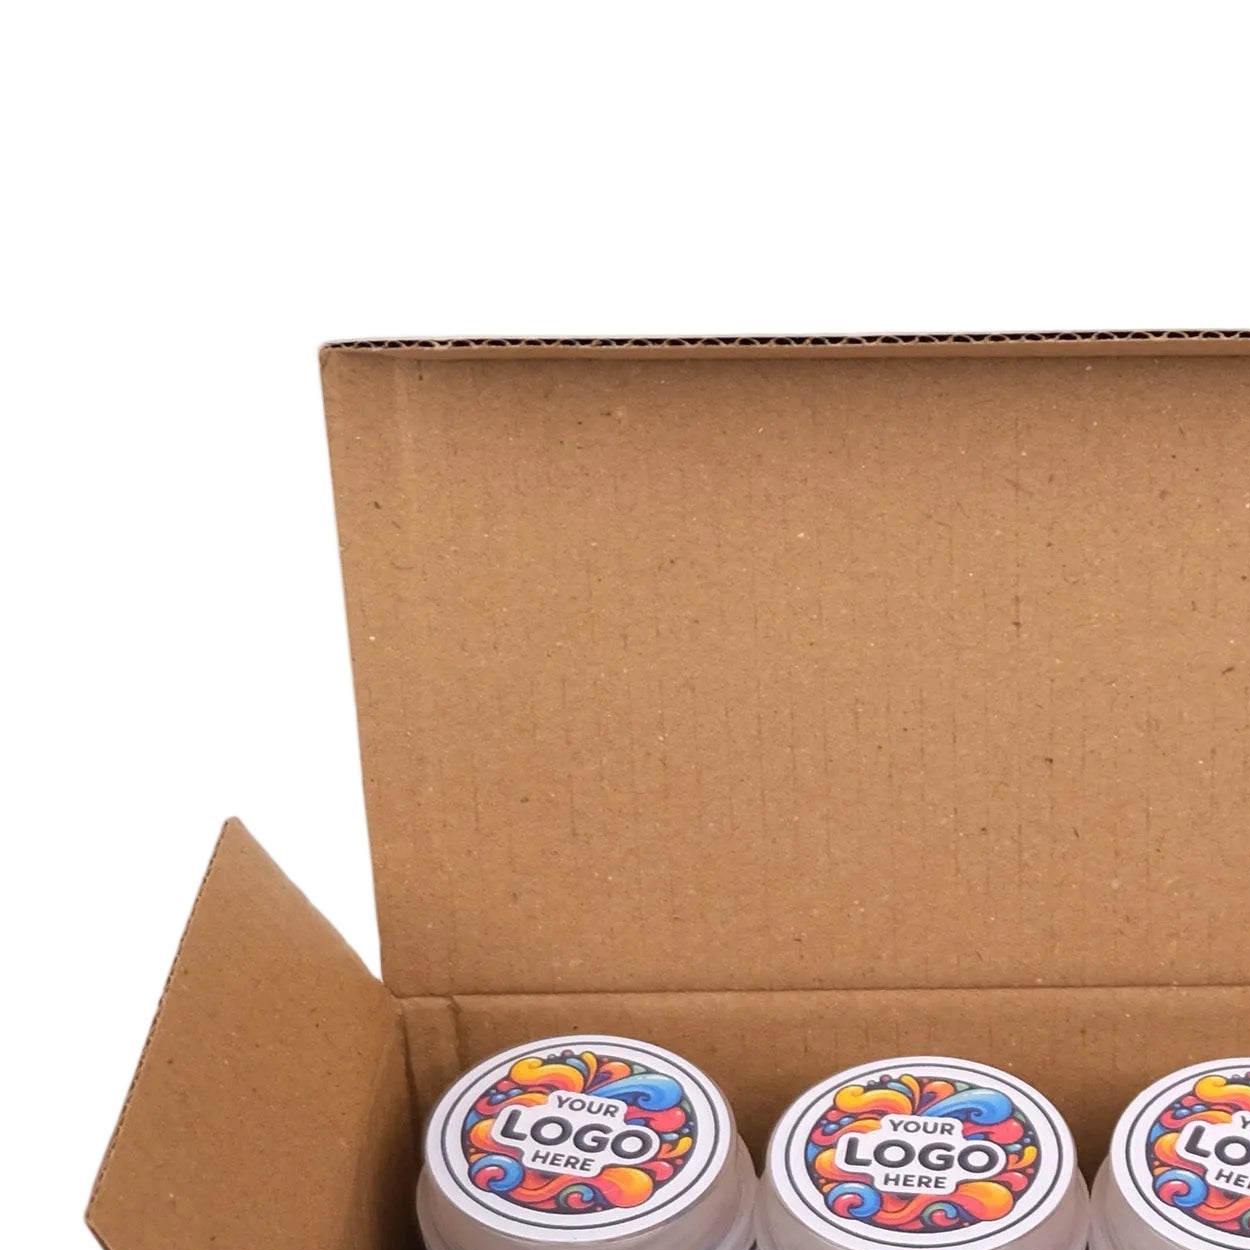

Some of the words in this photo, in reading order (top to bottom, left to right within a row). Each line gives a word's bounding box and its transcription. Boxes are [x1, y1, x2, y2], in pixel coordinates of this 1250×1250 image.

[556, 1095, 619, 1119] YOUR
[500, 1109, 653, 1160] LOGO
[889, 1119, 954, 1135] YOUR
[531, 1150, 595, 1172] HERE
[844, 1137, 999, 1174] LOGO
[883, 1173, 947, 1189] HERE
